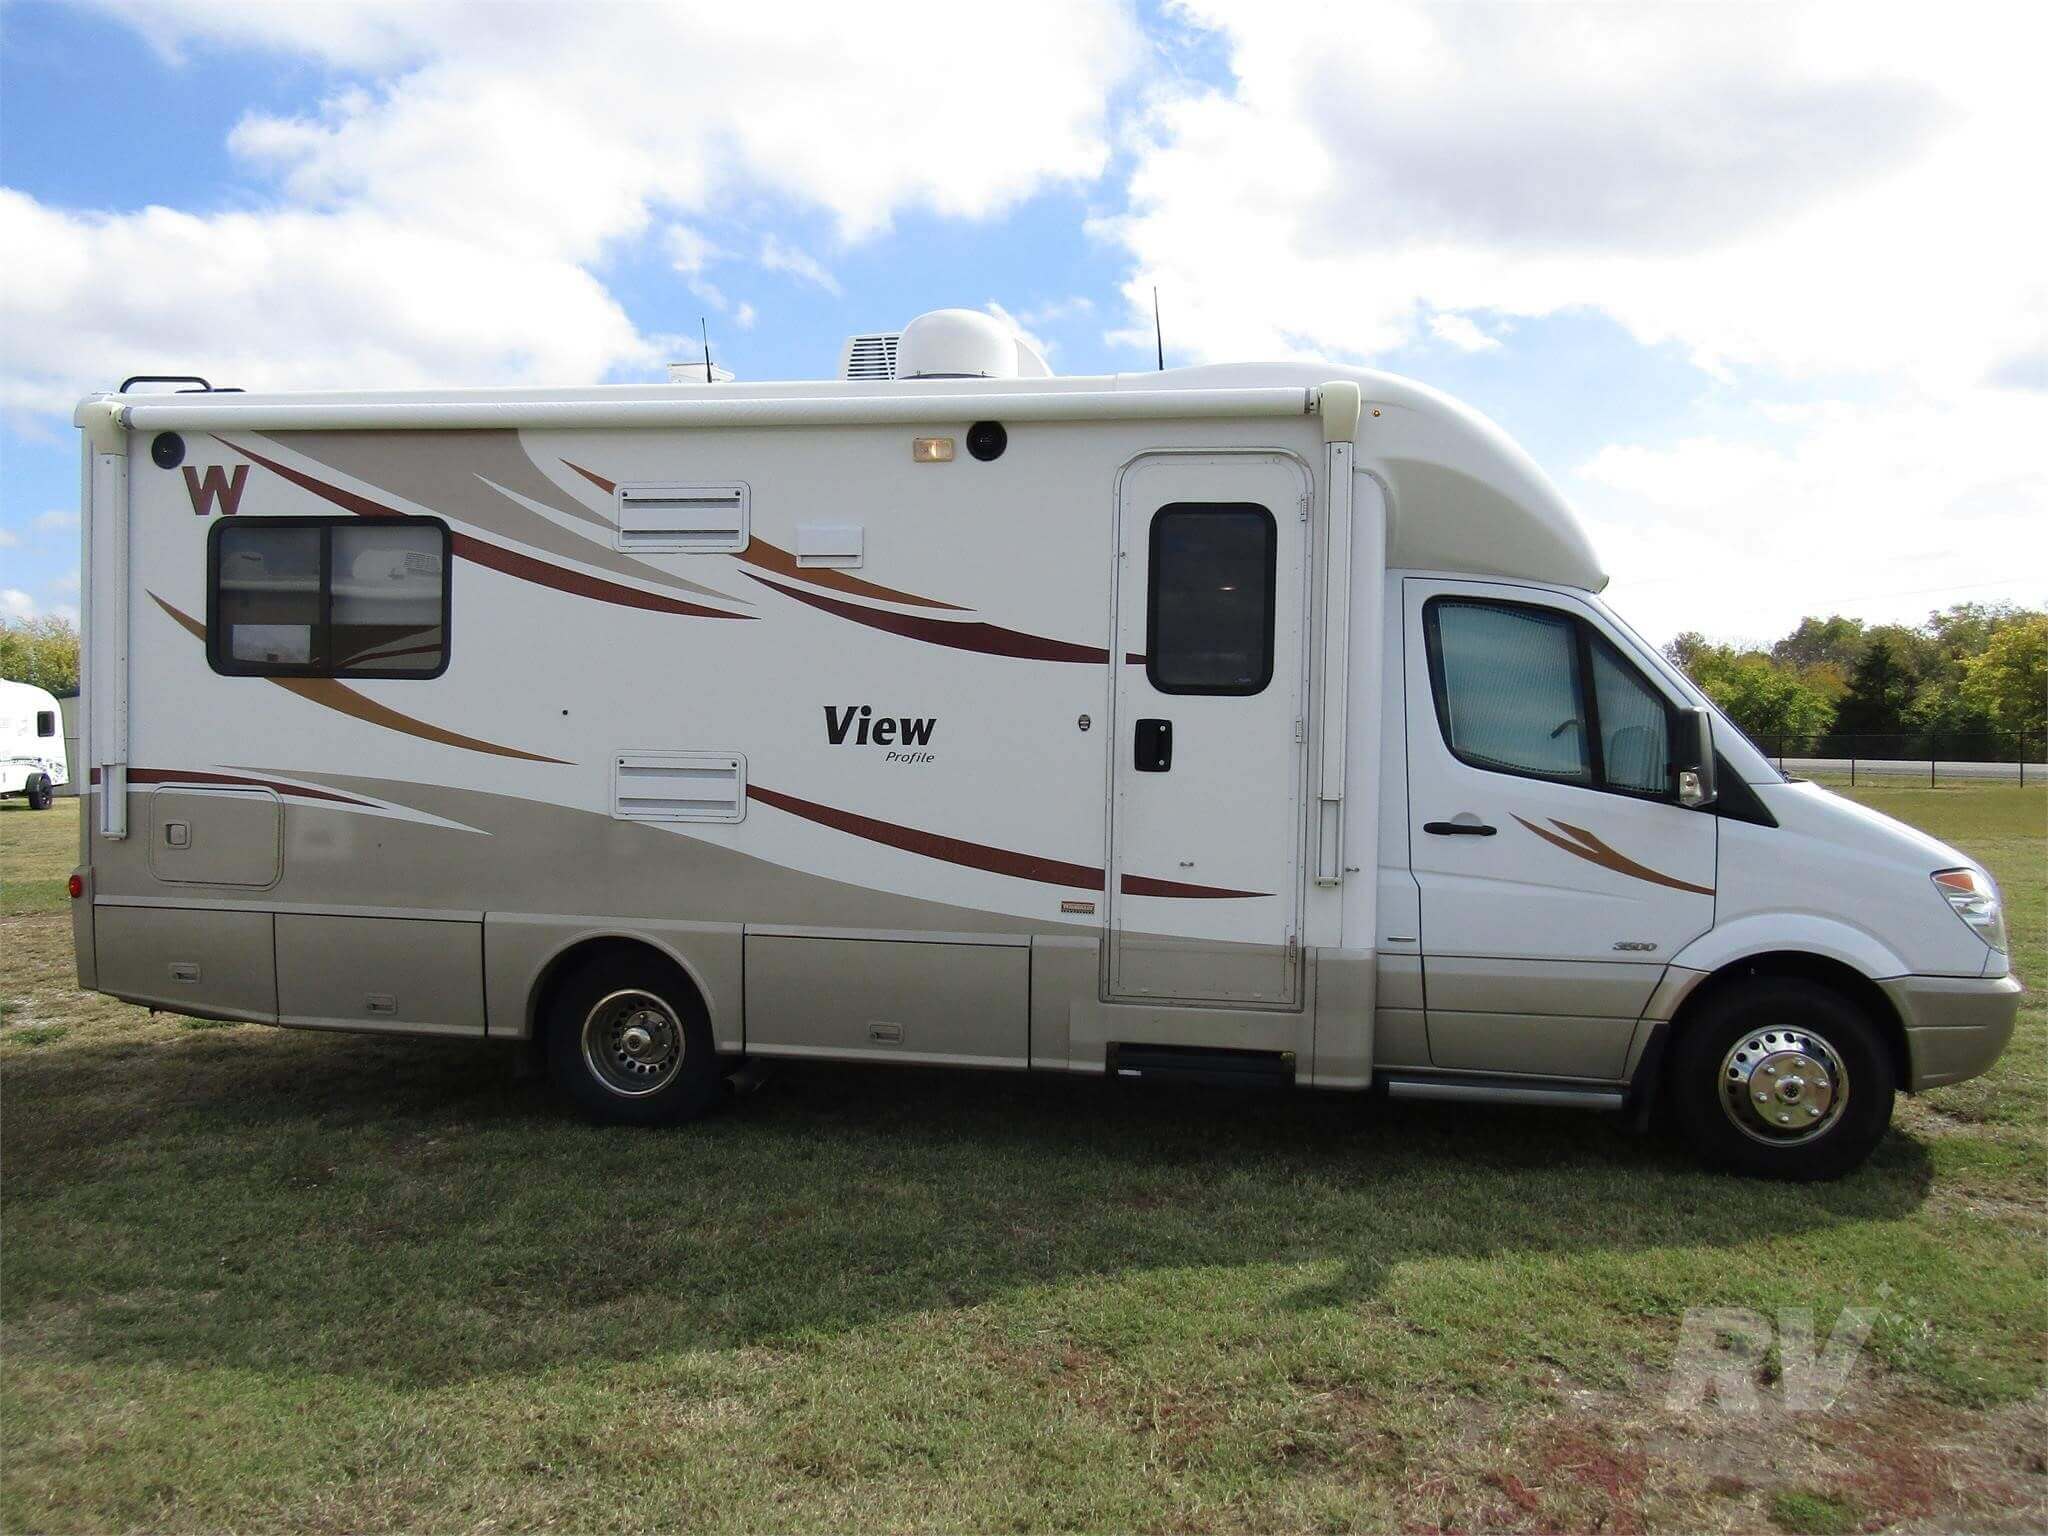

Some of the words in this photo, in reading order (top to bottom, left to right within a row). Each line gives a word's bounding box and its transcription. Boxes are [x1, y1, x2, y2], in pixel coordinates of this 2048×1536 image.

[182, 465, 250, 515] W
[823, 705, 937, 745] View
[885, 751, 935, 764] Profile
